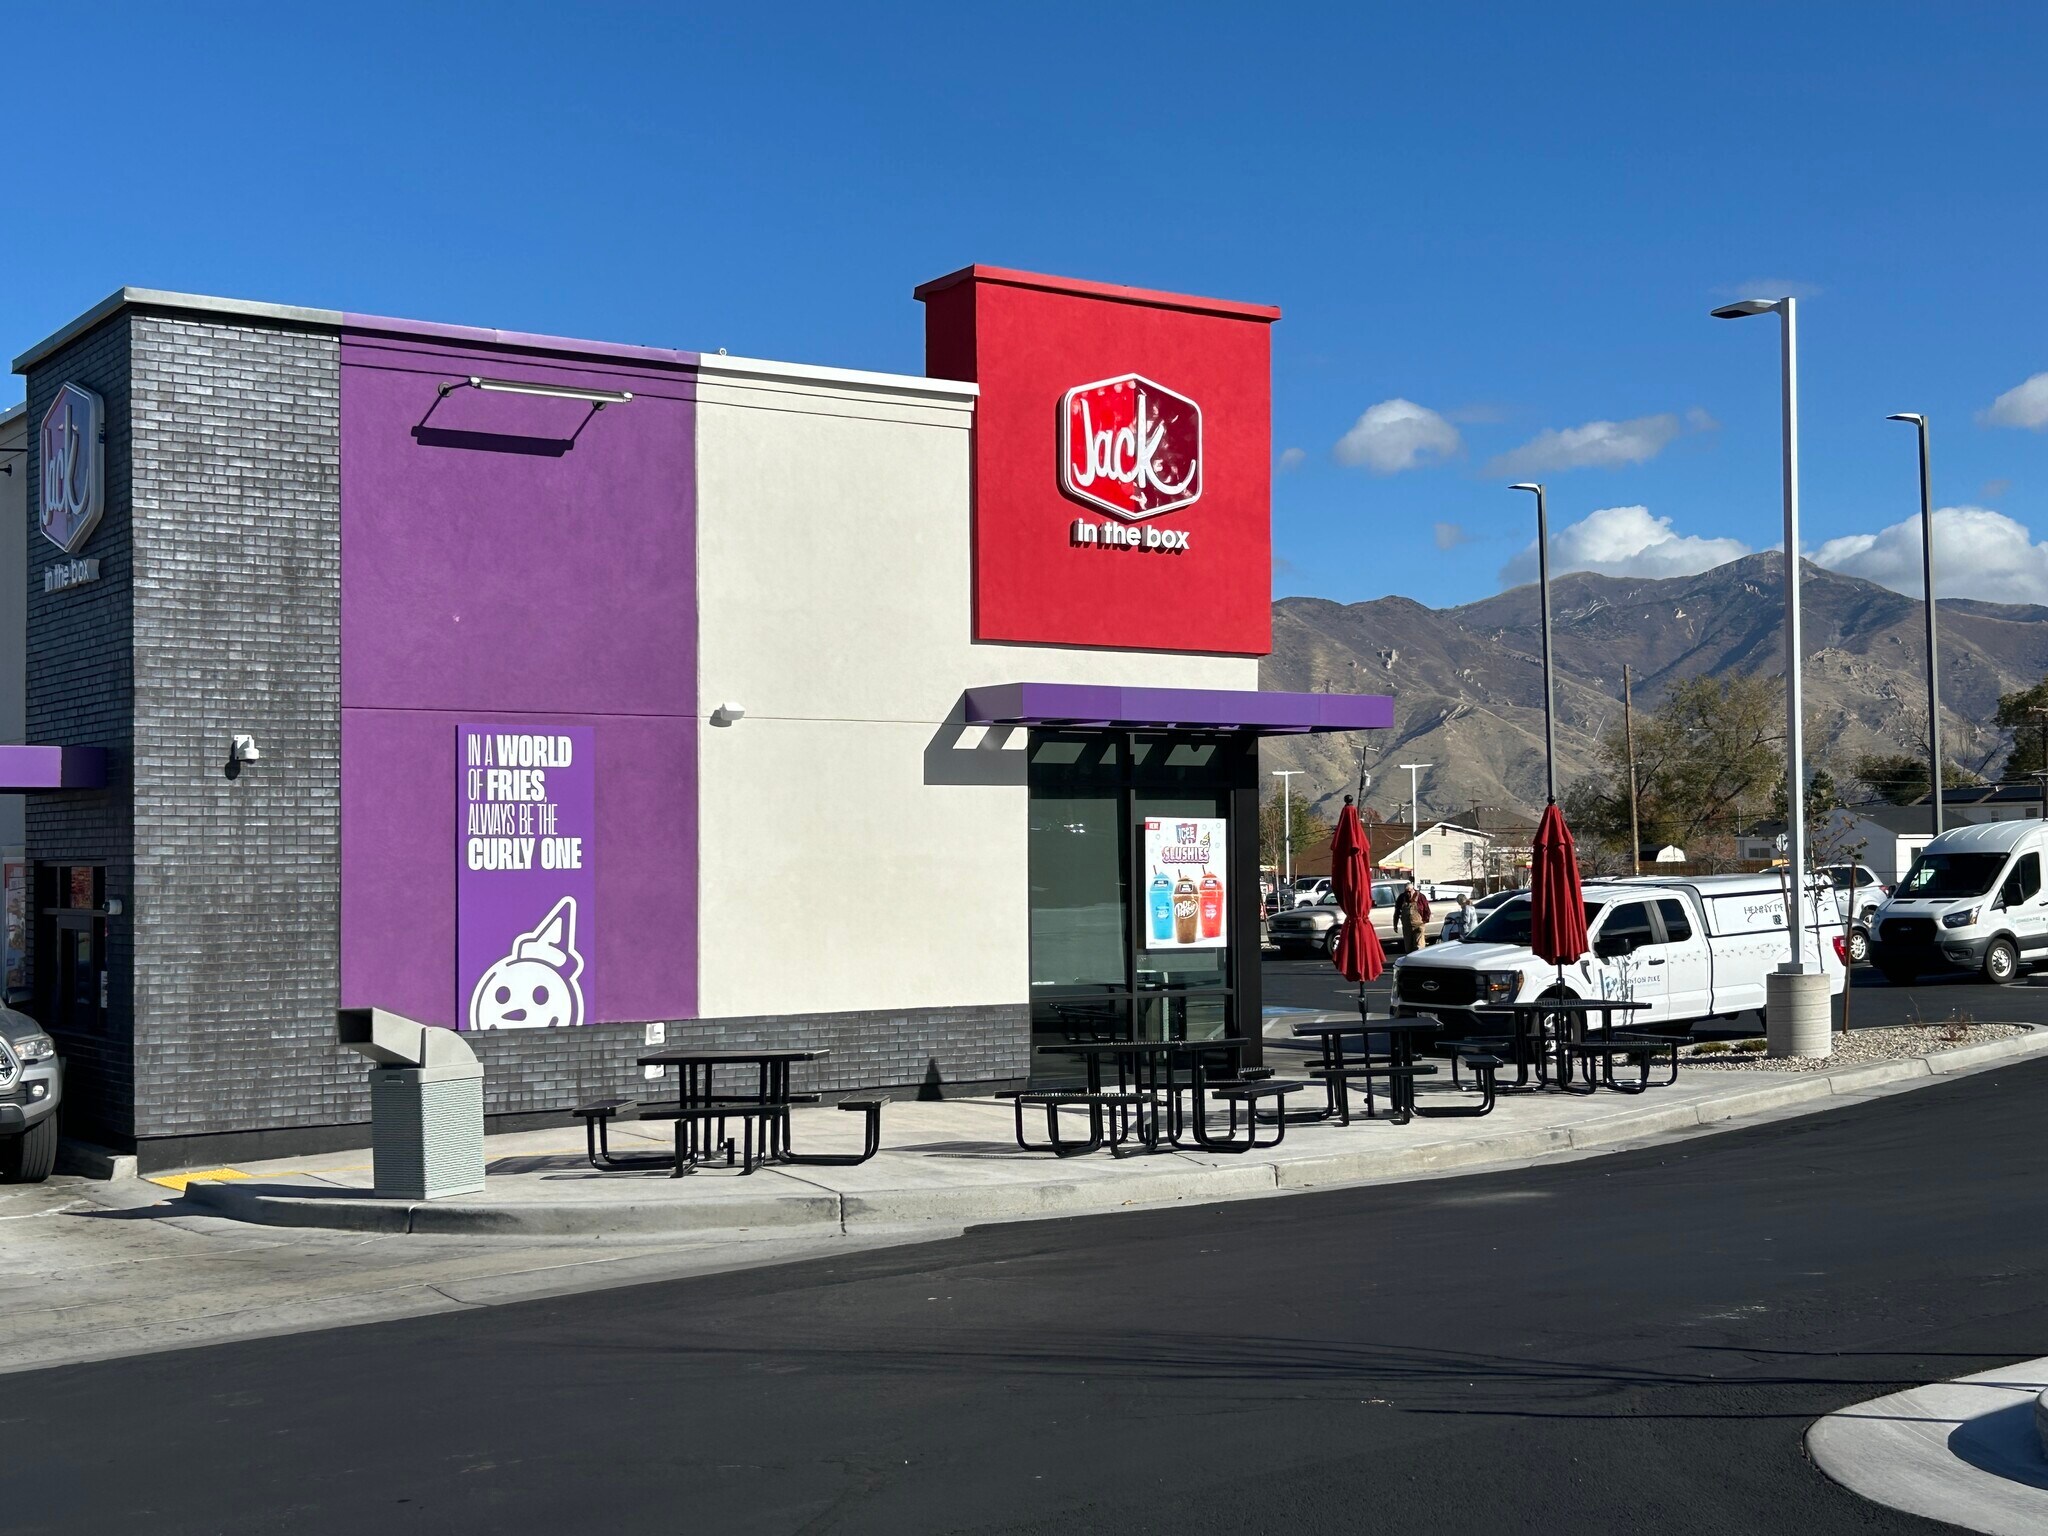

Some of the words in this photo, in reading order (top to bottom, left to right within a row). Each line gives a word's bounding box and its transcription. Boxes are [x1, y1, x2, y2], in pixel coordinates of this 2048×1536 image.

[1073, 393, 1196, 495] Jack
[42, 404, 89, 526] Jack
[1077, 518, 1098, 543] in
[1104, 521, 1141, 546] the
[1146, 525, 1190, 550] box
[44, 567, 53, 592] in
[55, 563, 69, 587] the
[70, 559, 89, 583] box
[468, 734, 480, 766] IN
[484, 735, 493, 766] A
[496, 735, 573, 768] WORLD
[468, 768, 483, 801] OF
[487, 769, 547, 803] FRIES,
[468, 803, 515, 835] ALWAYS
[519, 804, 534, 835] BE
[537, 804, 558, 835] THE
[468, 837, 535, 870] CURLY
[540, 837, 582, 870] ONE
[1163, 847, 1209, 862] SLUSHIES
